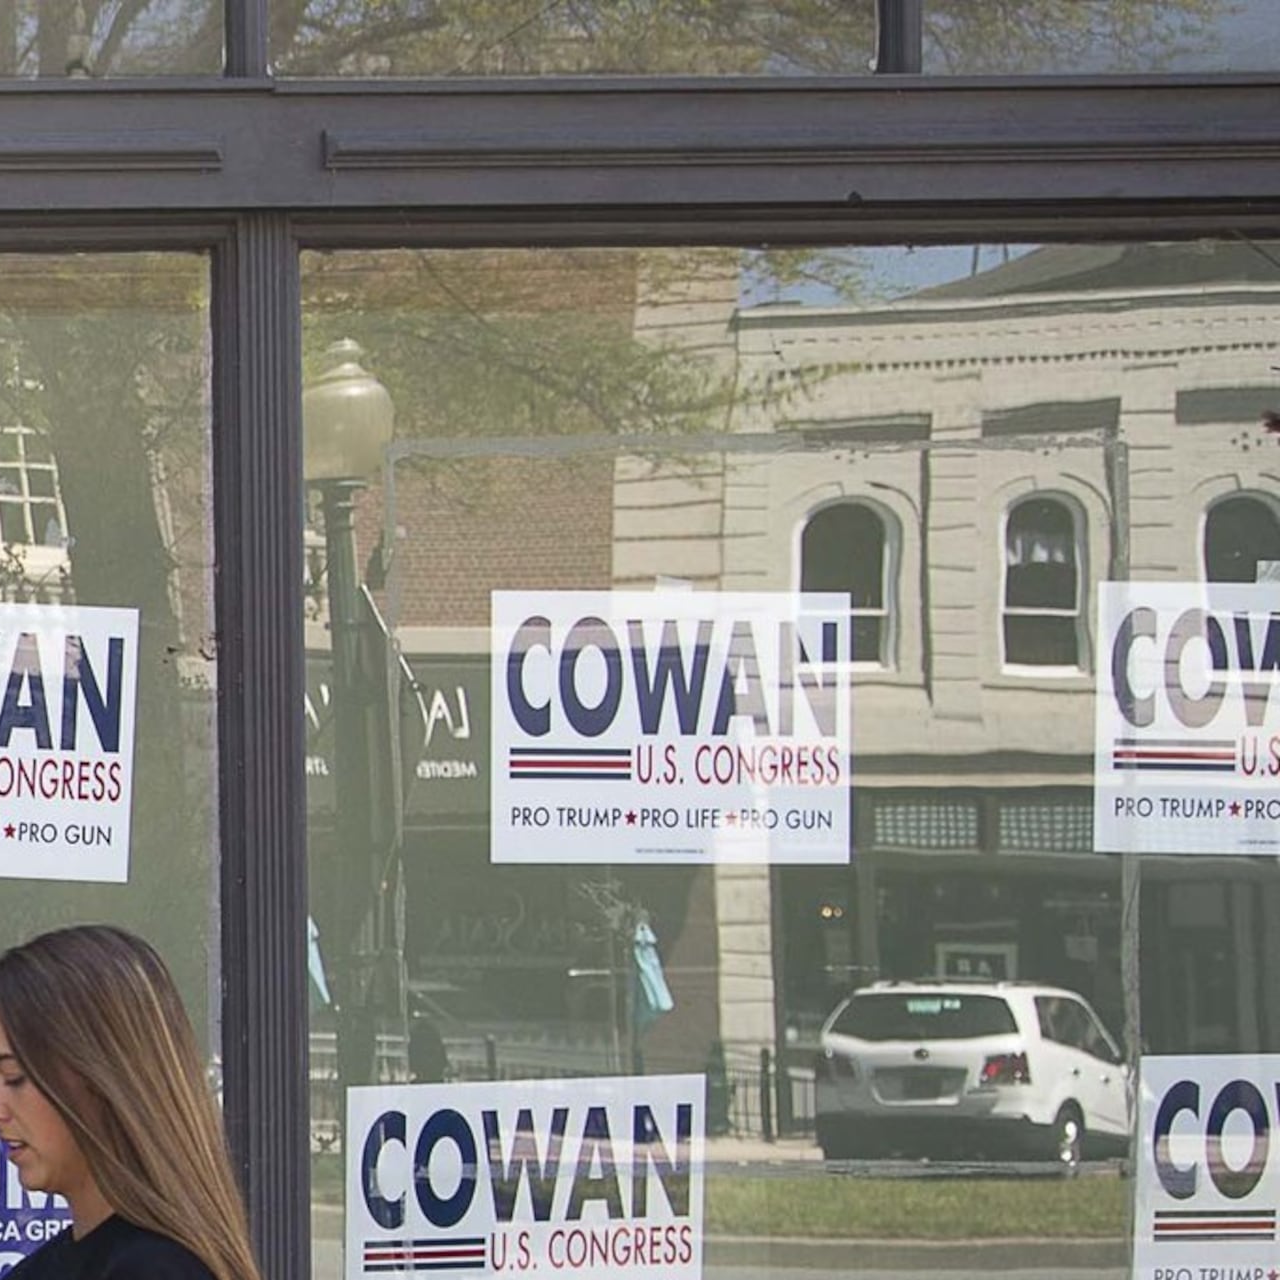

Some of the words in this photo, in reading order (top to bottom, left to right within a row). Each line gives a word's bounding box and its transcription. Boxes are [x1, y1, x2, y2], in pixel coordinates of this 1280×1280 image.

[506, 615, 838, 738] COWAN
[1112, 606, 1280, 728] COW
[636, 744, 684, 785] U.S.
[695, 745, 841, 786] CONGRESS
[1242, 736, 1280, 775] U.S
[511, 807, 550, 827] PRO
[557, 807, 622, 828] TRUMP
[640, 808, 679, 829] PRO
[686, 808, 721, 829] LIFE
[740, 809, 779, 830] PRO
[785, 809, 833, 830] GUN
[1115, 797, 1153, 818] PRO
[1161, 797, 1226, 818] TRUMP
[18, 823, 57, 844] PRO
[64, 825, 112, 847] GUN
[361, 1103, 693, 1230] COWAN
[490, 1231, 537, 1270] U.S.
[548, 1225, 693, 1268] CONGRESS
